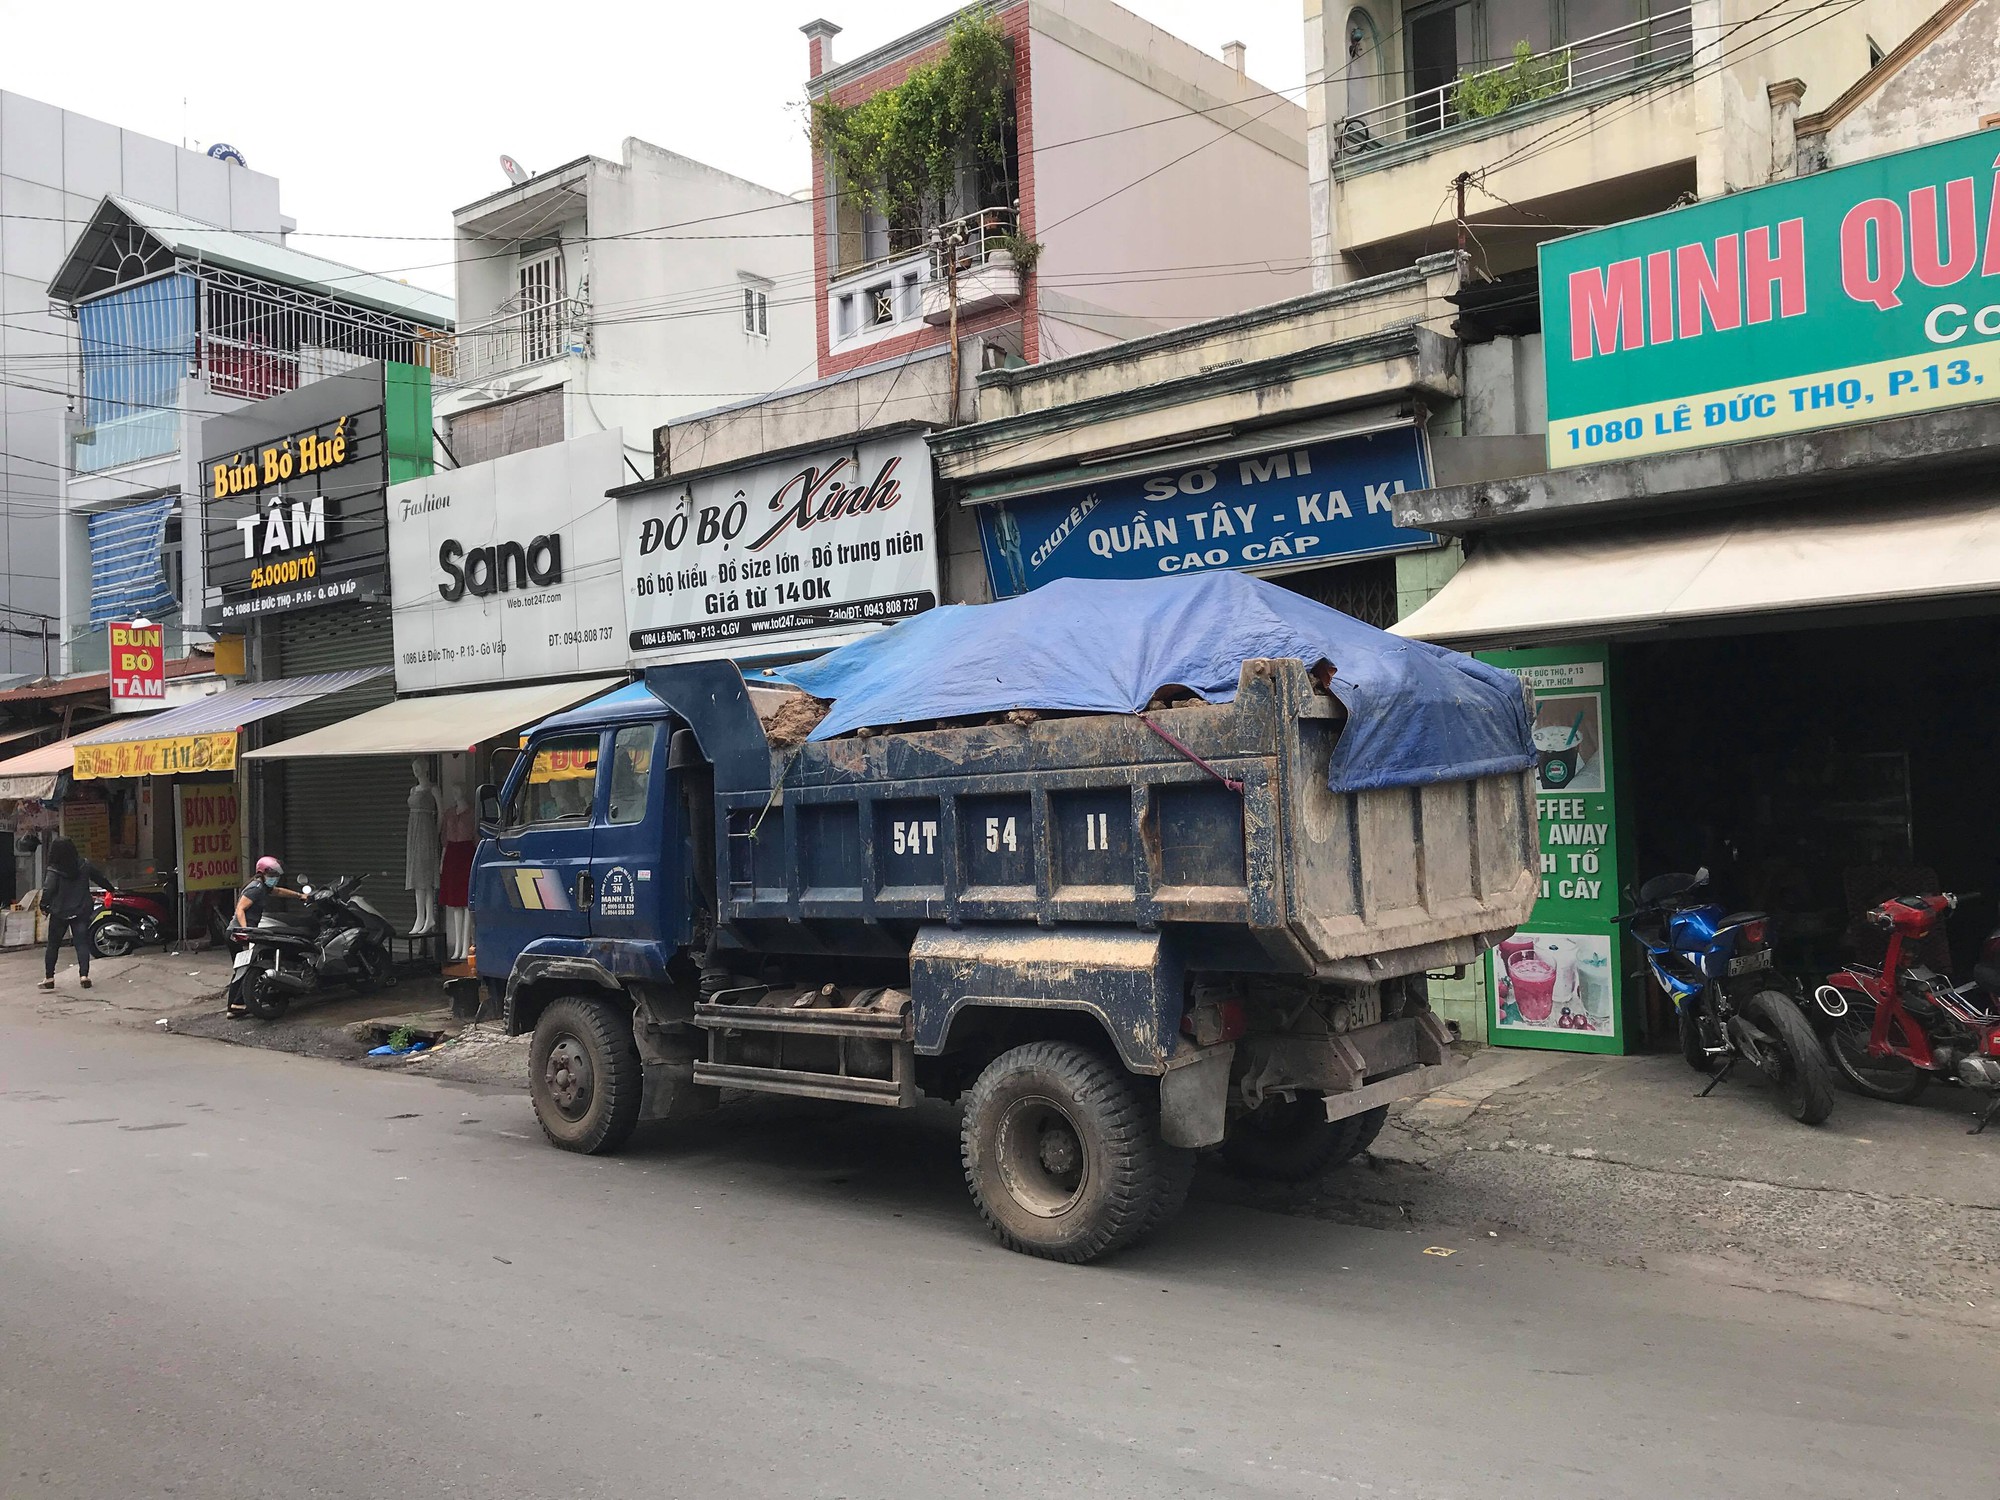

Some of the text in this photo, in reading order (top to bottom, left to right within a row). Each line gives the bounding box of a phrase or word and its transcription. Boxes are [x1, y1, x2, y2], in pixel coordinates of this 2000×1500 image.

[1568, 216, 1807, 362] MINH
[1566, 360, 1984, 450] 1080 LÊ ĐỨC THỌ, P.13,
[214, 416, 347, 498] Bún Bò Huế
[1144, 450, 1312, 502] SƠ MI
[398, 494, 451, 522] Fashion
[696, 489, 748, 552] BỘ
[744, 455, 902, 552] Xinh
[236, 496, 324, 559] TÂM
[1030, 492, 1100, 566] CHUYÊN:
[1088, 510, 1179, 559] QUẦN
[1186, 502, 1254, 542] TÂY
[1298, 490, 1353, 525] KA
[251, 550, 316, 590] 25.000Đ/TÔ
[438, 534, 562, 602] Sana
[637, 530, 924, 596] Đồ bộ kiểu Đồ size lớn Đồ trung niên
[1158, 531, 1320, 572] CAO CẤP
[252, 599, 260, 612] LÊ
[277, 594, 291, 608] THỌ
[296, 590, 312, 604] P.16
[318, 588, 326, 599] Q.
[328, 583, 338, 596] GÒ
[340, 578, 356, 594] VẤP
[705, 577, 831, 614] Giá từ 140k
[548, 633, 562, 646] ĐT:
[599, 627, 612, 640] 737
[640, 634, 656, 646] 1084
[657, 632, 666, 644] Lê
[666, 630, 682, 642] Đức
[682, 628, 696, 642] Thọ
[701, 626, 716, 638] P.13
[720, 622, 740, 636] Q.GV
[864, 604, 884, 617] 0943
[886, 602, 901, 616] 808
[903, 598, 918, 612] 737
[122, 650, 154, 672] BÒ
[402, 652, 417, 664] 1086
[418, 650, 426, 663] Lê
[442, 648, 454, 662] Thọ
[480, 642, 490, 656] Gò
[492, 640, 506, 656] Vấp
[1568, 666, 1584, 675] P.13
[114, 674, 162, 696] TÂM
[162, 740, 191, 769] TÂM
[192, 826, 232, 855] HUẾ
[893, 820, 938, 855] 54T
[985, 816, 1018, 852] 54
[1548, 824, 1608, 845] AWAY
[1567, 848, 1600, 874] TỐ
[1558, 876, 1602, 899] CÂY
